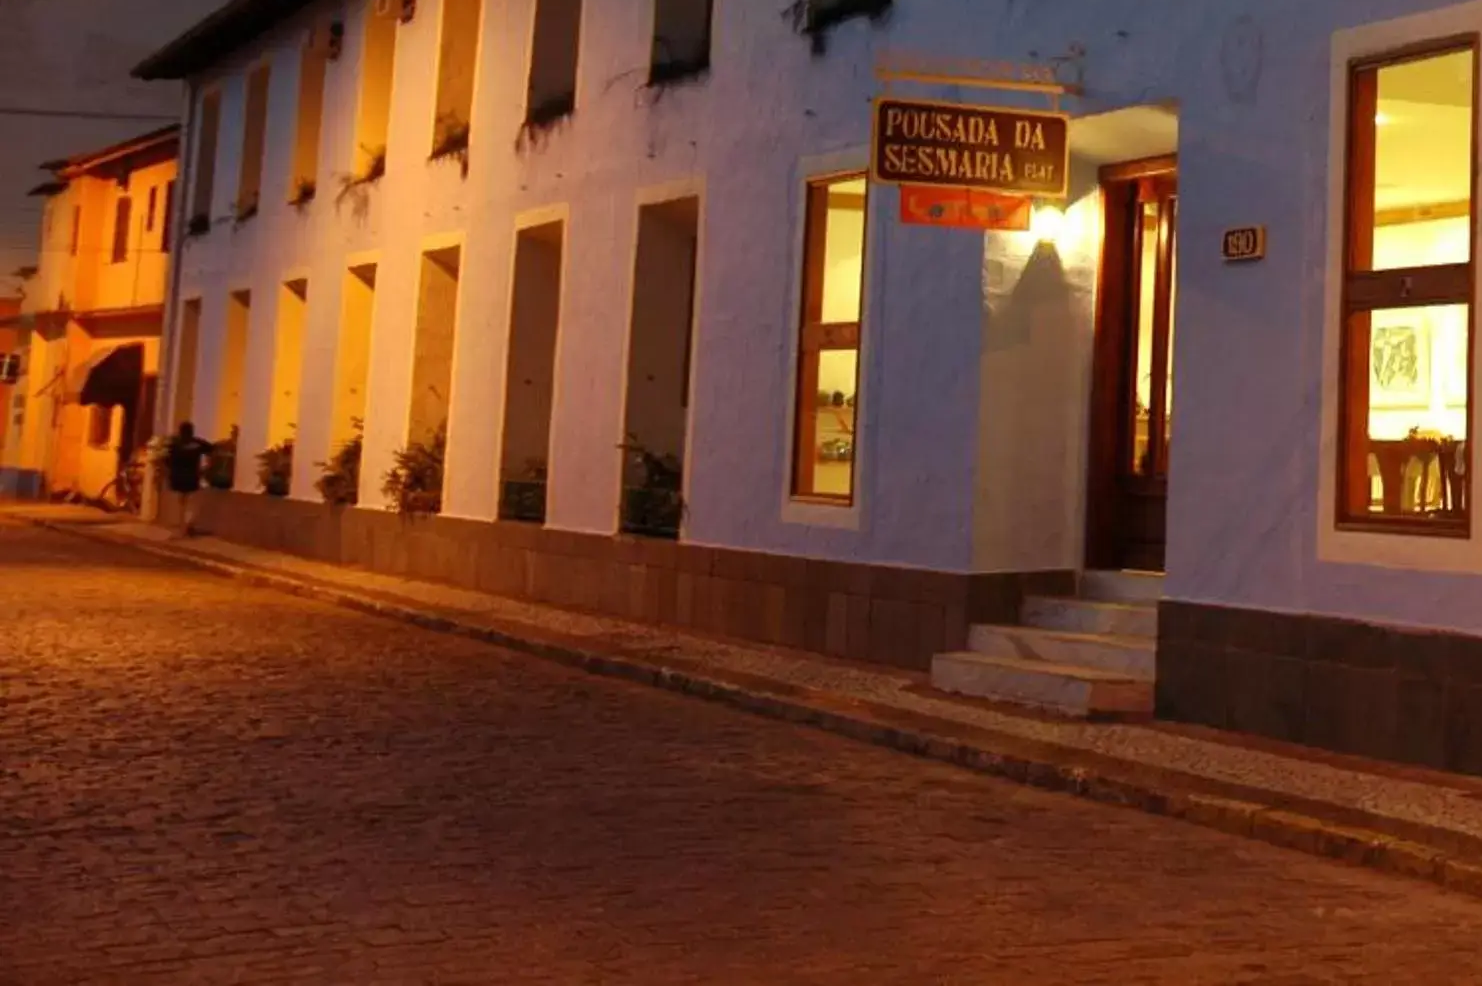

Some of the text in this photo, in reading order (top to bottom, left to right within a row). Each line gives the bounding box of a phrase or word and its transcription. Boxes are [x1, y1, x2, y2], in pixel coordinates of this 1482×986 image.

[886, 108, 1046, 150] POUSADA DA
[884, 143, 1014, 182] SESMARIA
